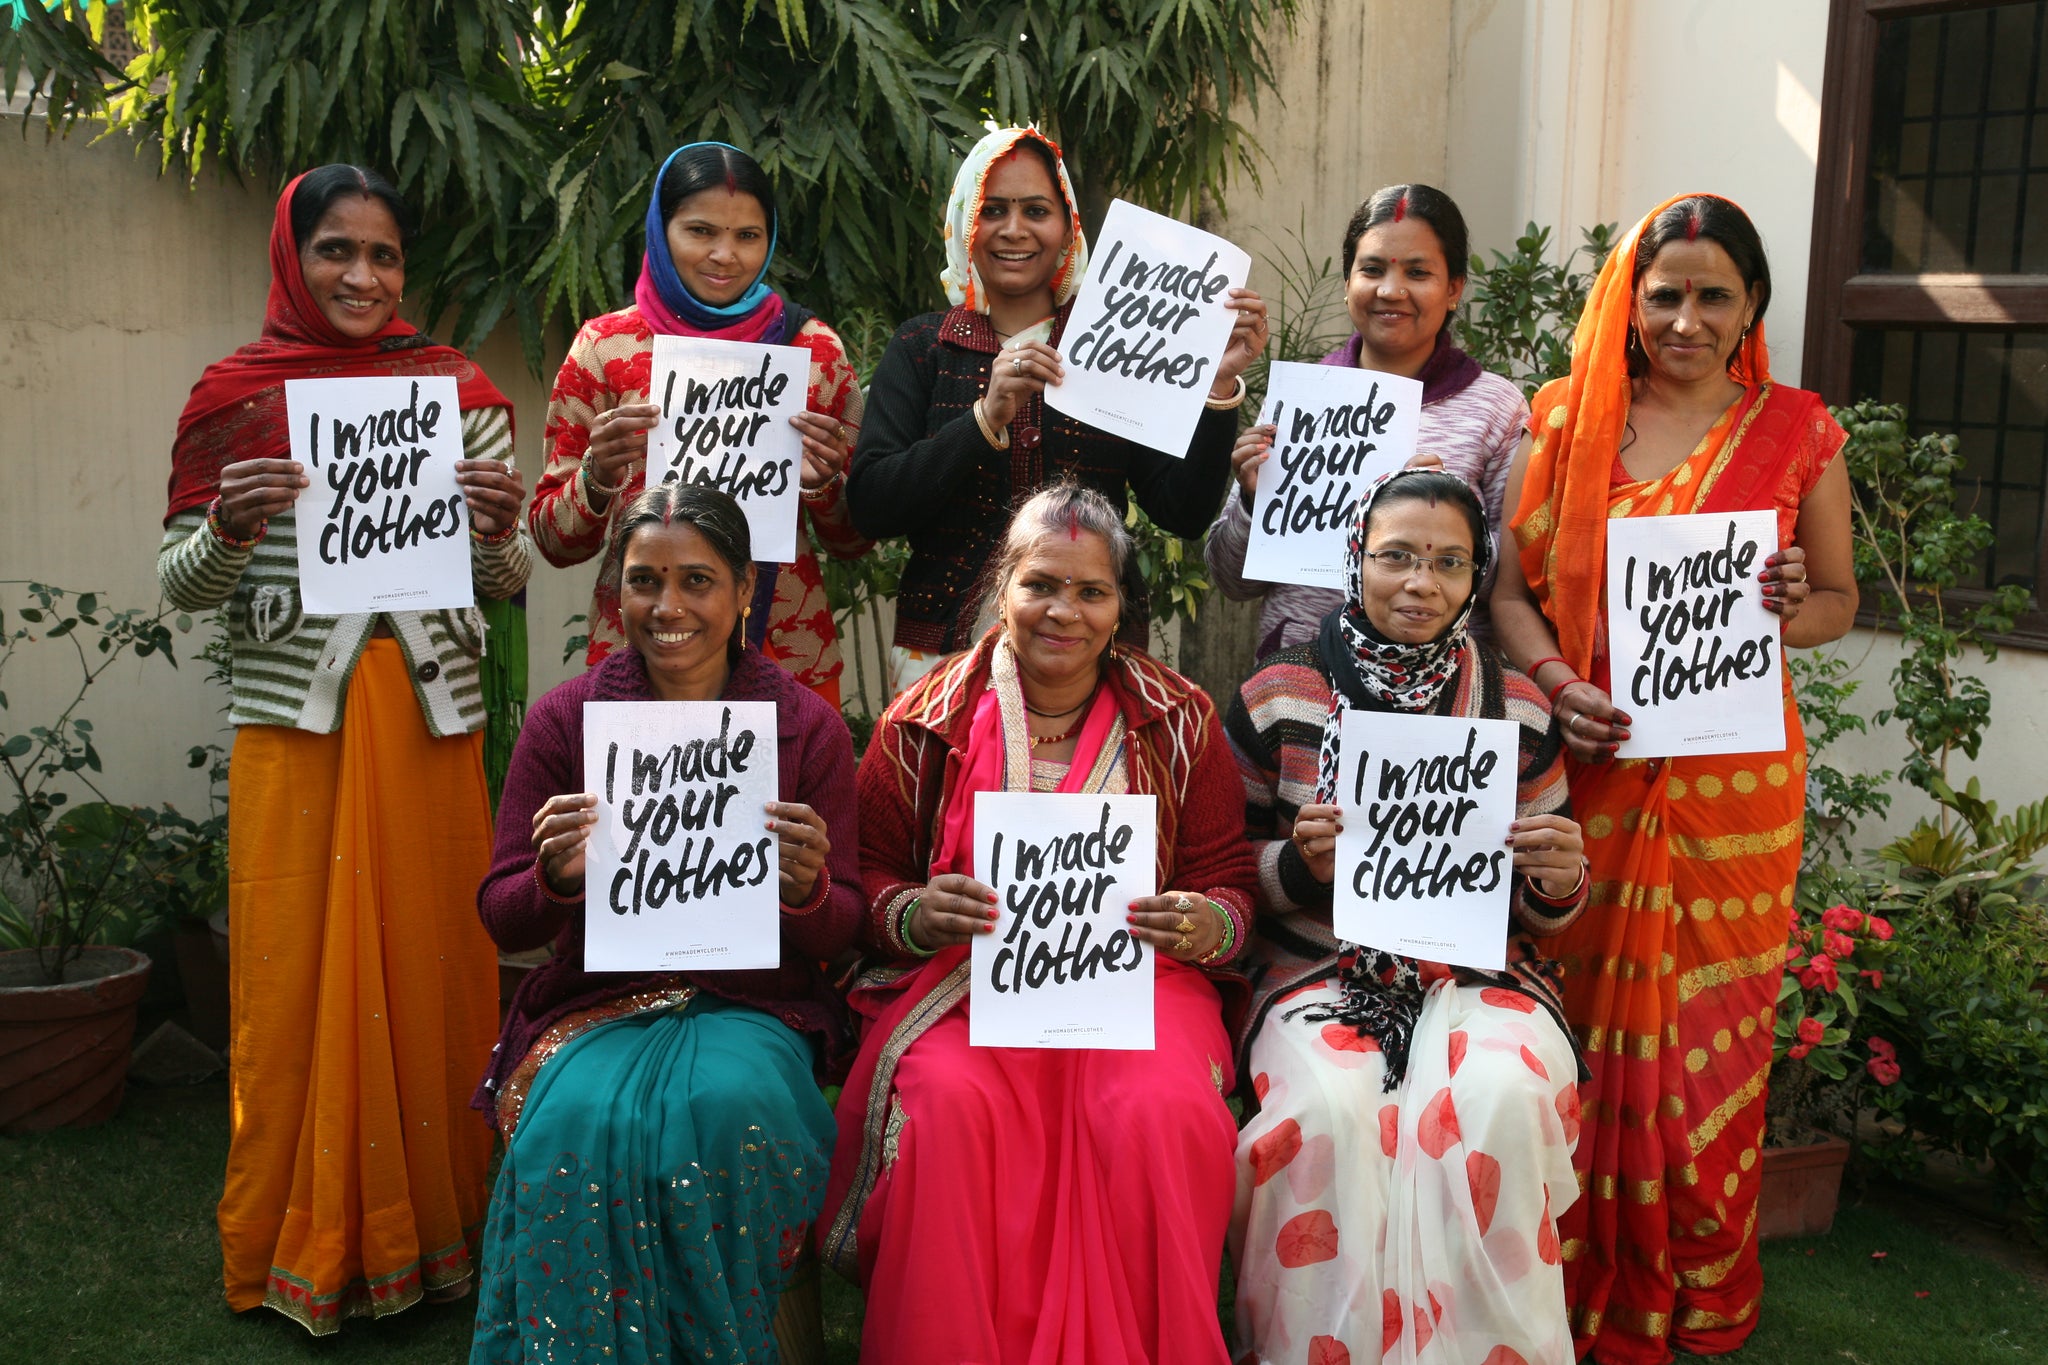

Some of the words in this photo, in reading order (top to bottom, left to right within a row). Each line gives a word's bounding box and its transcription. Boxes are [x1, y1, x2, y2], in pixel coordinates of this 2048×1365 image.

[1098, 240, 1123, 284] I
[1120, 251, 1229, 303] made
[1091, 285, 1200, 334] your
[663, 370, 676, 419] I
[684, 353, 789, 415] made
[1069, 325, 1209, 389] clothes
[311, 413, 319, 468] I
[334, 380, 441, 459] made
[670, 412, 771, 466] your
[1271, 400, 1283, 448] I
[1290, 382, 1396, 443] made
[327, 447, 431, 519] your
[1275, 441, 1377, 495] your
[319, 494, 462, 565] clothes
[1262, 480, 1357, 536] cloth
[1625, 556, 1636, 610] I
[1648, 520, 1758, 602] made
[1640, 588, 1744, 661] your
[1631, 635, 1773, 707] clothes
[606, 741, 618, 804] I
[632, 706, 755, 795] made
[1355, 750, 1369, 806] I
[1378, 727, 1498, 801] made
[620, 782, 740, 863] your
[991, 832, 1003, 889] I
[1015, 802, 1133, 881] made
[1364, 797, 1478, 857] your
[609, 837, 772, 915] clothes
[1353, 842, 1505, 902] clothes
[1003, 872, 1117, 944] your
[665, 946, 728, 956] #WHOMADEMYCLOTHES
